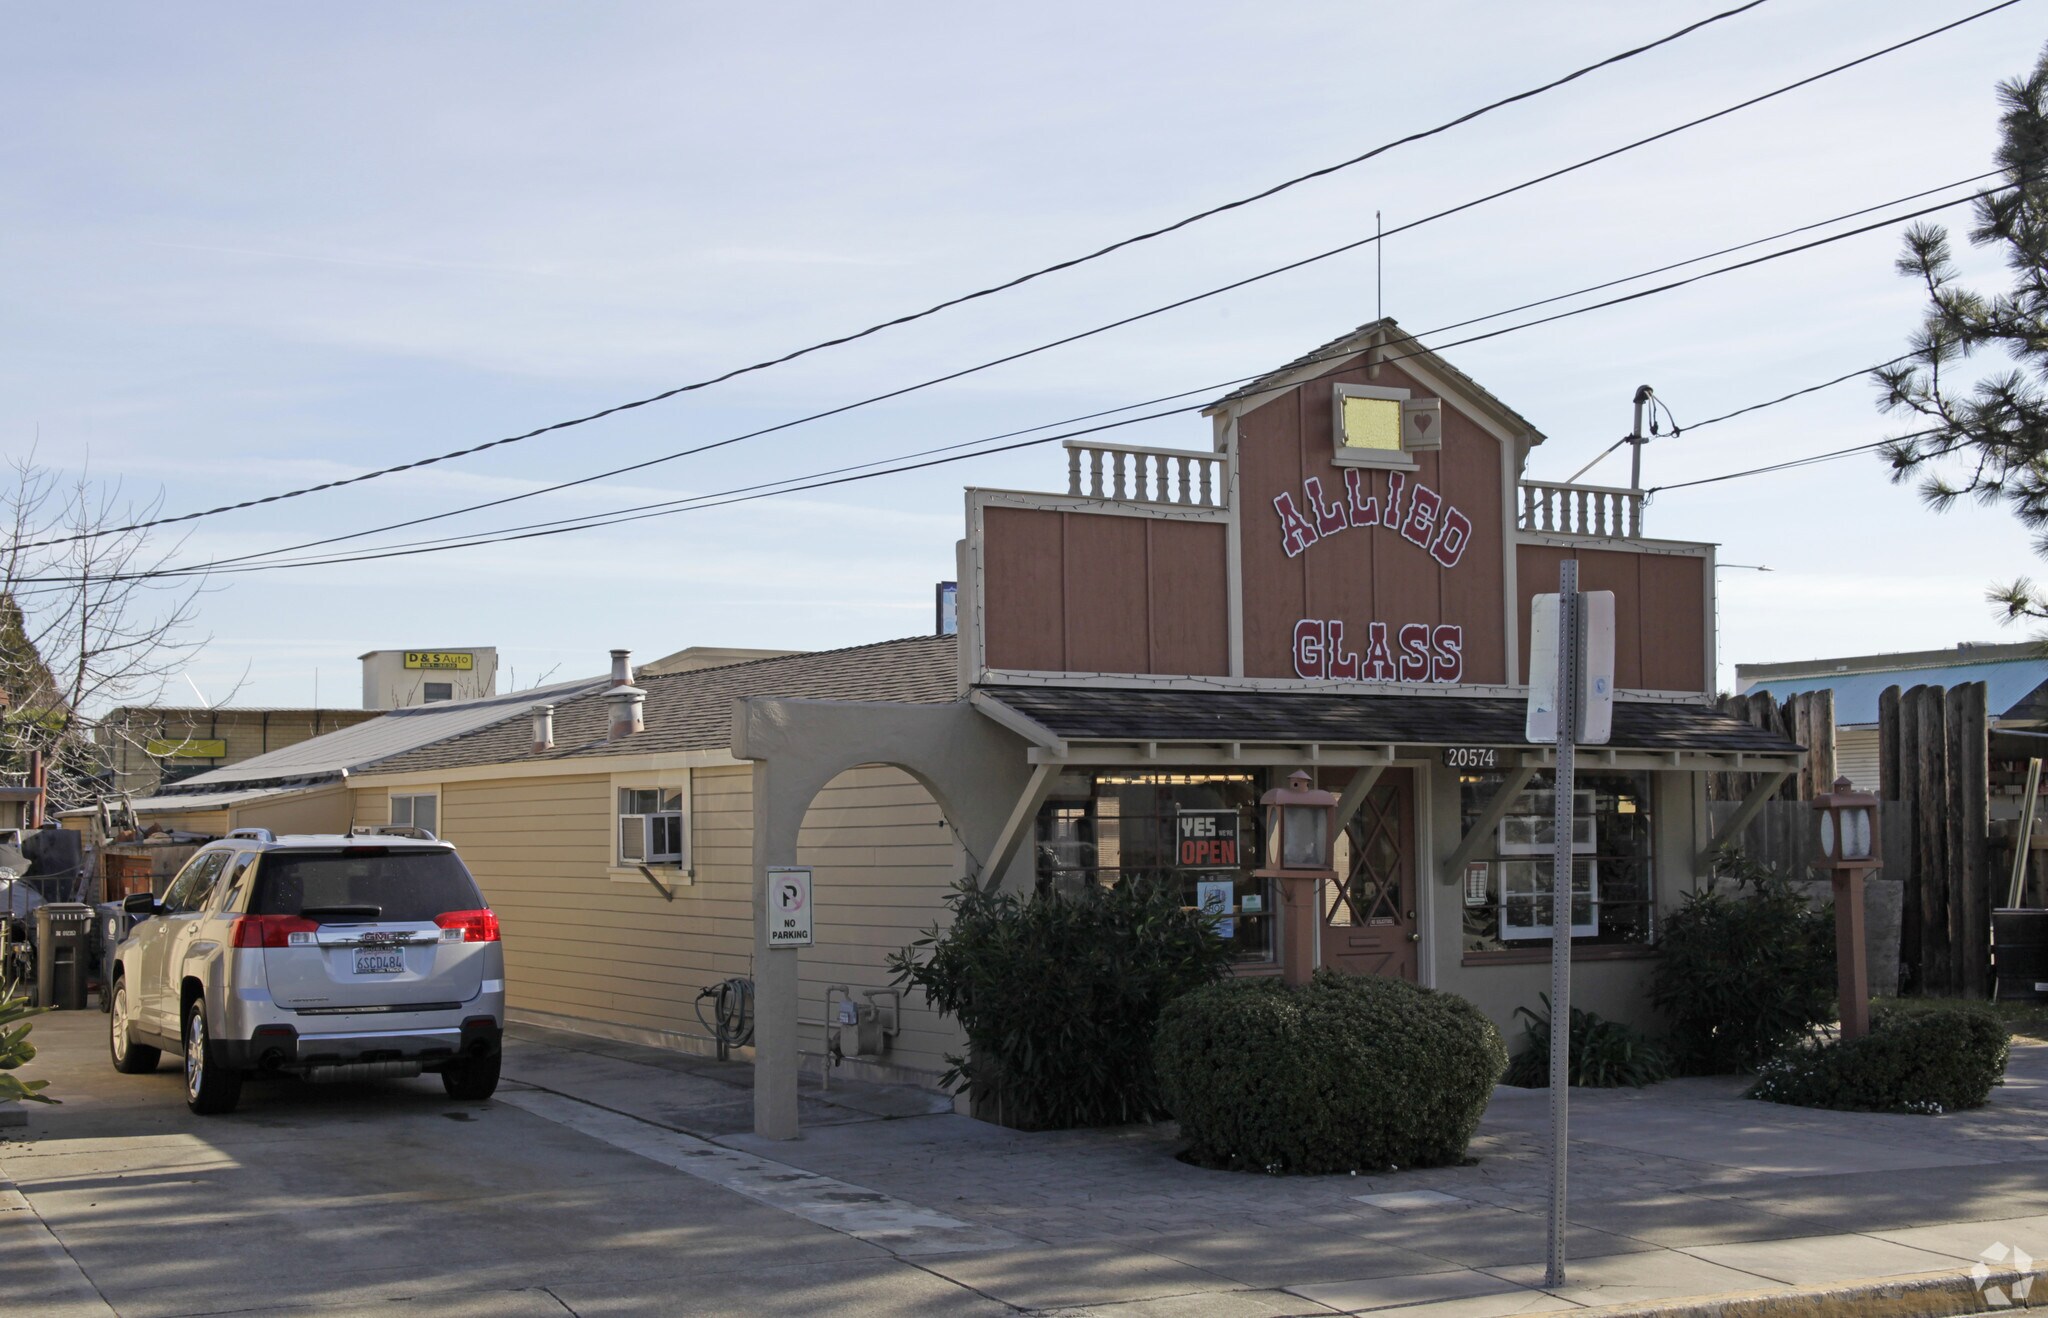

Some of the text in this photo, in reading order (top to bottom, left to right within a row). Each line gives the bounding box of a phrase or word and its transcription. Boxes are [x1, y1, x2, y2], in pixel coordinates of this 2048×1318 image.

[1273, 468, 1472, 567] ALLIED
[409, 653, 469, 664] D & S Auto
[1293, 619, 1462, 684] GLASS
[1449, 748, 1495, 767] 20574
[1181, 817, 1216, 837] YES
[1181, 840, 1236, 865] OPEN
[784, 919, 796, 928] NO
[772, 930, 808, 940] PARKING
[357, 956, 402, 969] 6SCD484
